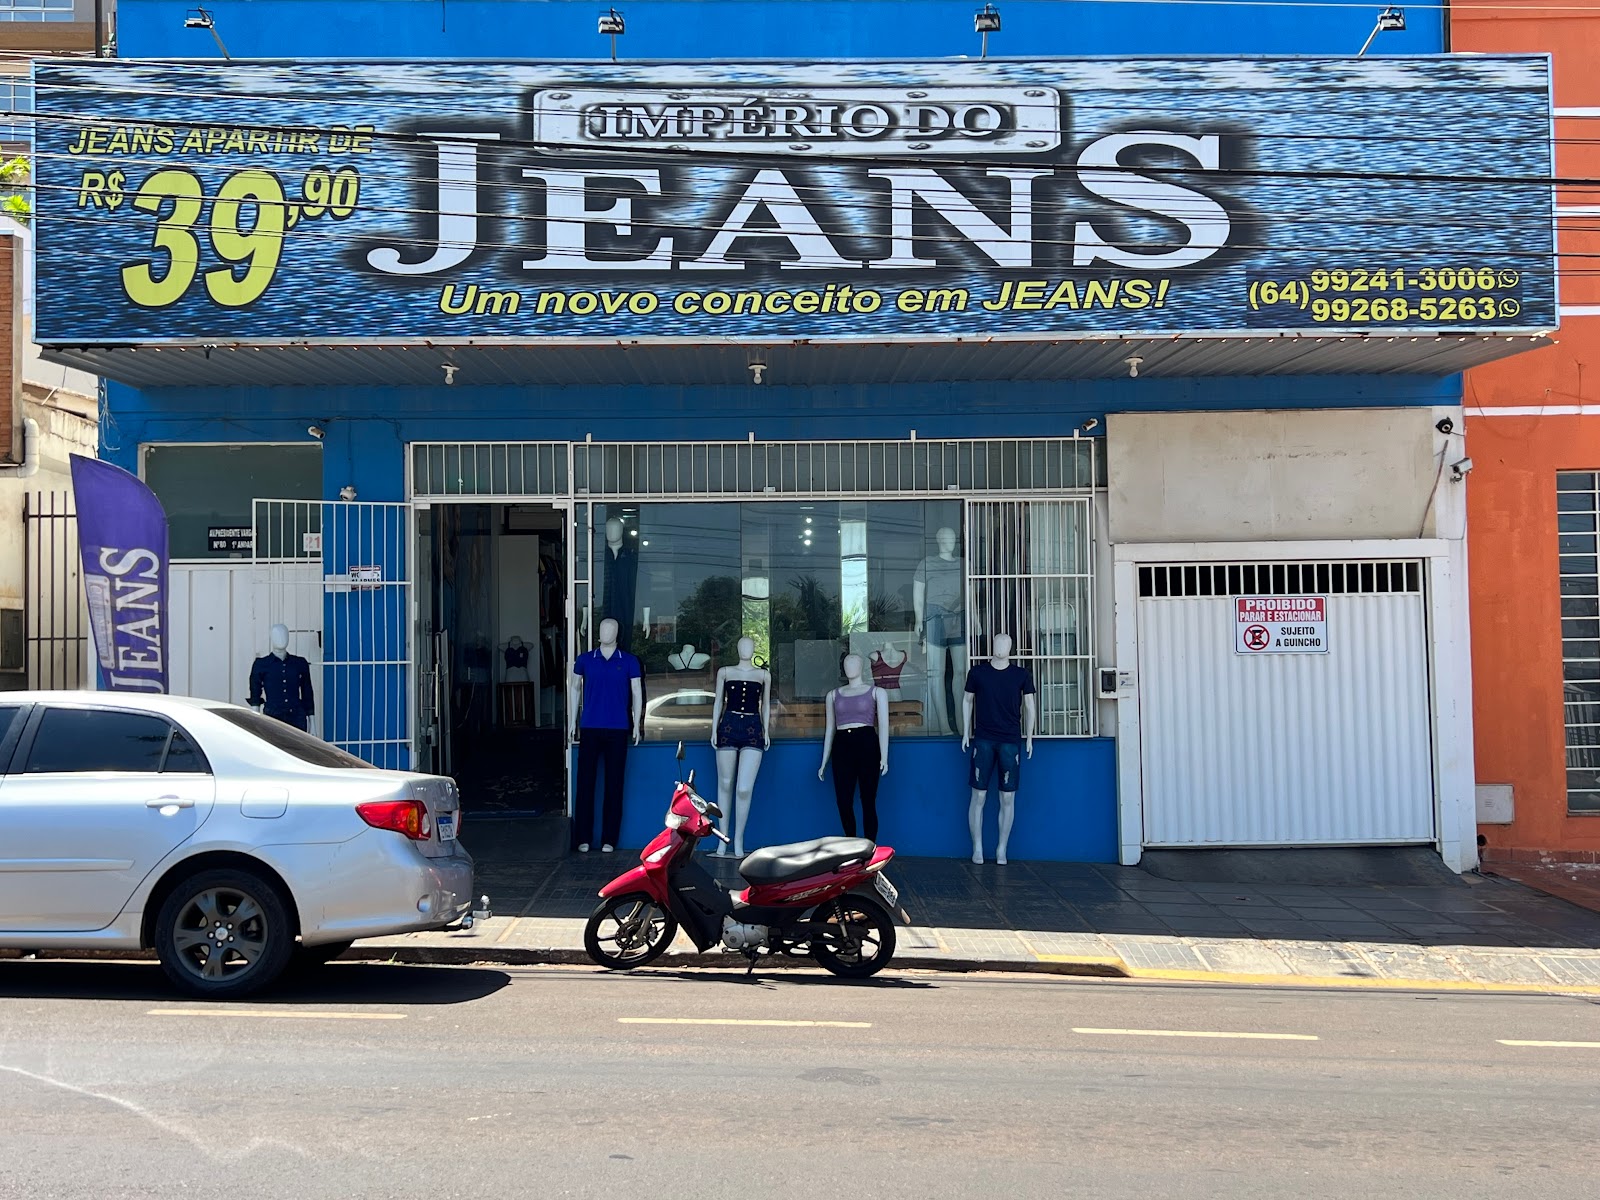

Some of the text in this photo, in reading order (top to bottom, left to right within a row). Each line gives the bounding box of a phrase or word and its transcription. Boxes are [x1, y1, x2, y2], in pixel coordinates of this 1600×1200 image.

[598, 97, 1002, 139] IMPÉRIO DO
[69, 127, 174, 155] JEANS
[329, 126, 375, 154] DE
[78, 170, 125, 210] R$
[366, 130, 1231, 275] JEANS
[439, 279, 1170, 314] Um novo conceito em JEANS!
[1248, 267, 1496, 310] (64) 99241-3006
[1310, 297, 1496, 322] 99268-5263
[100, 547, 165, 694] JEANS
[1239, 610, 1322, 622] PARAR E ESTACIONAR
[1245, 598, 1317, 611] PROIBIDO
[1275, 638, 1321, 647] A GUINCHO
[1280, 626, 1315, 636] SUJEITO
